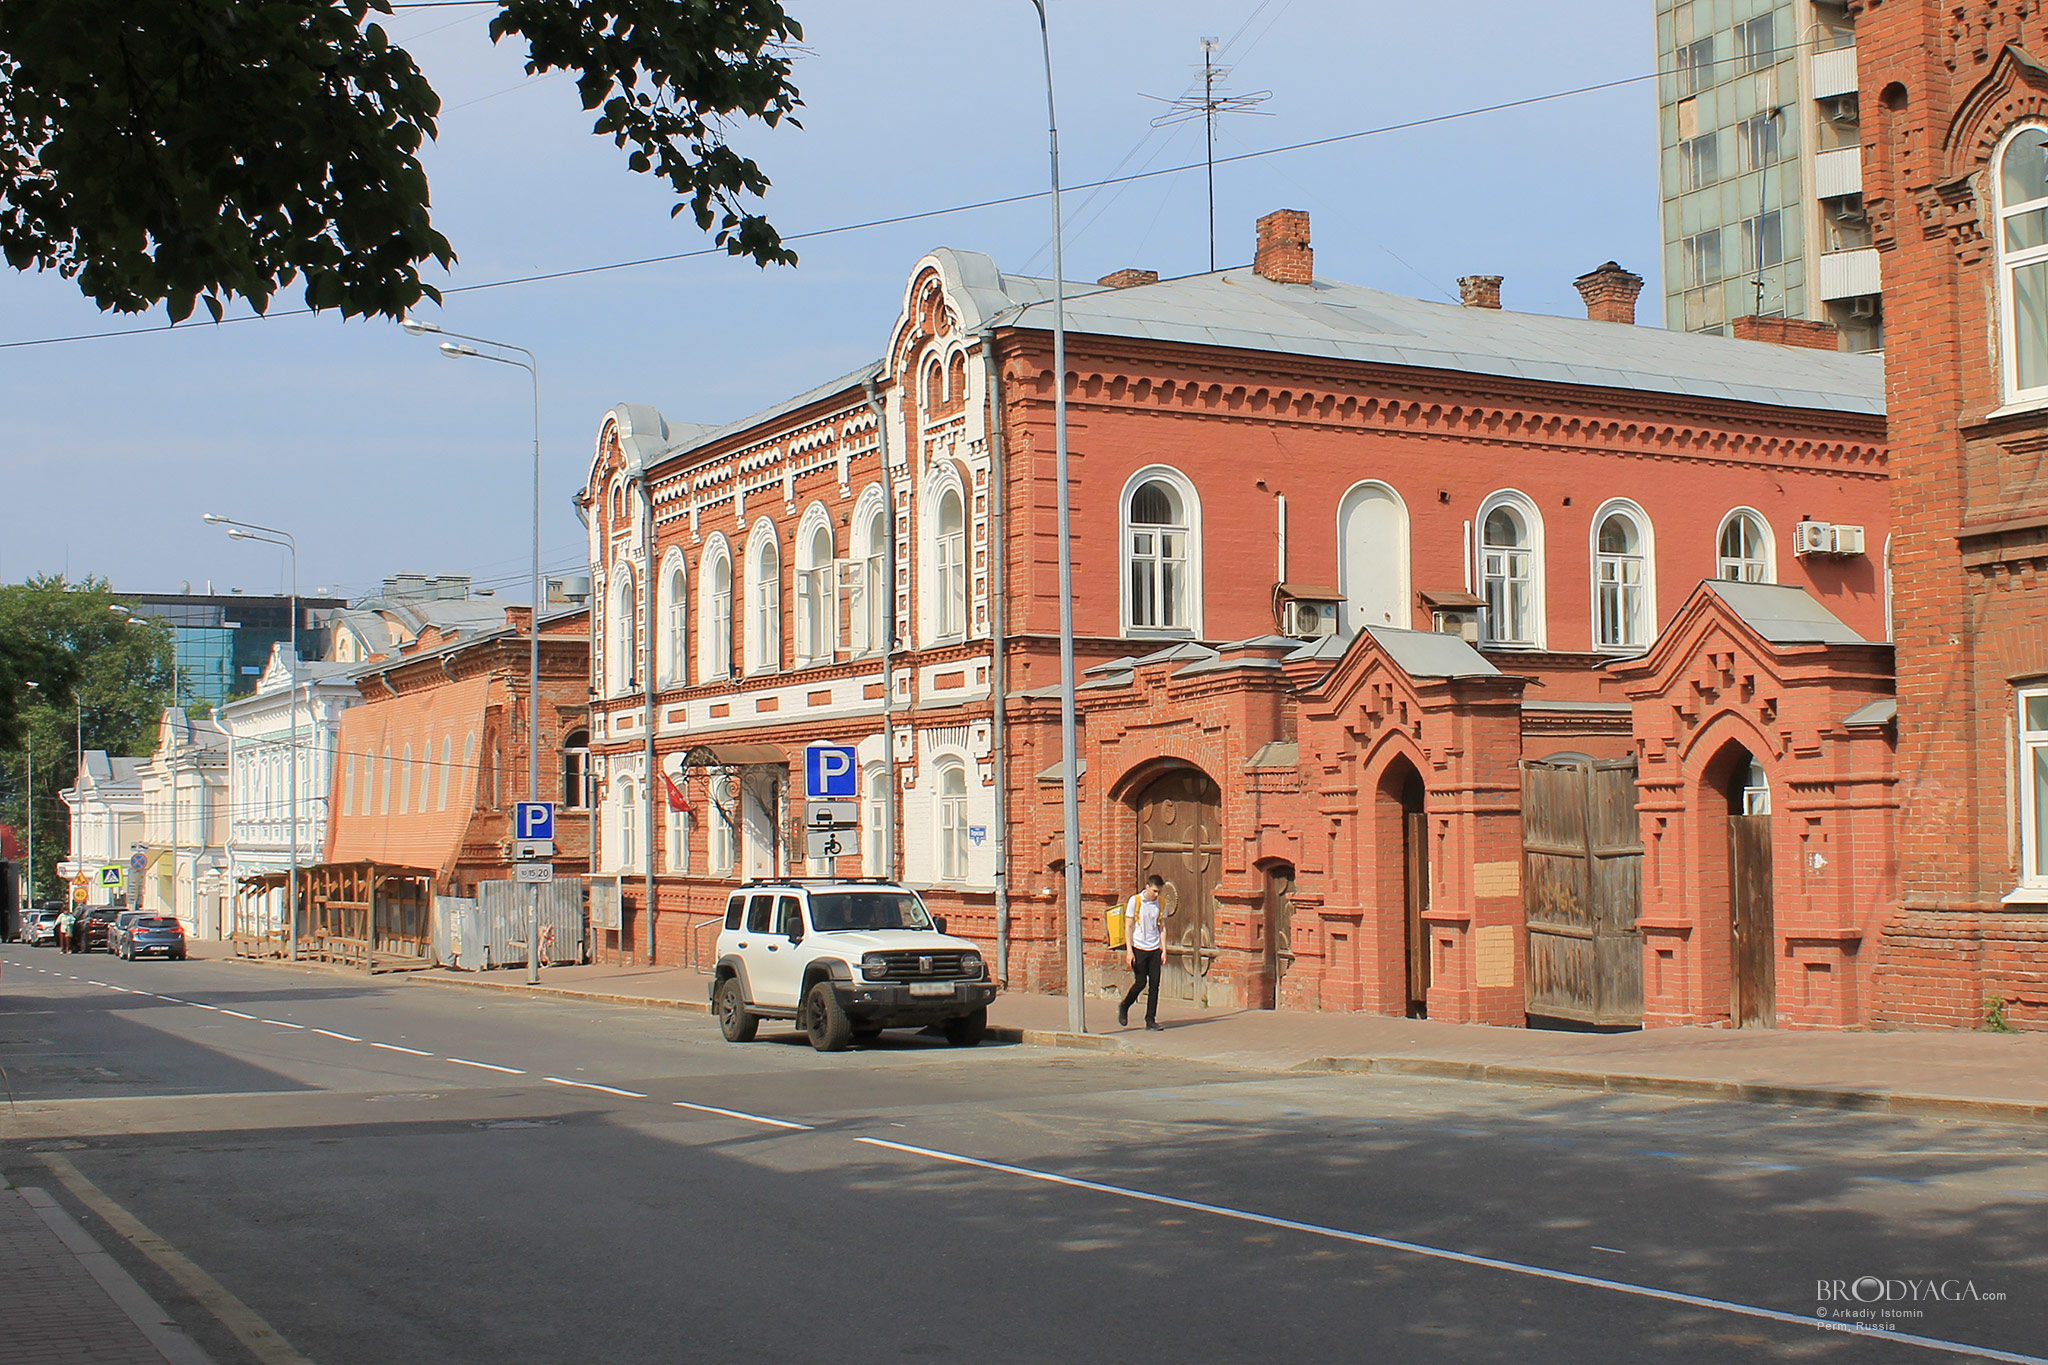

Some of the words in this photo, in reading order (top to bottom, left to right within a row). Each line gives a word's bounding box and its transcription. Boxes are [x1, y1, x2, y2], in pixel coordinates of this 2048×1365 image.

[819, 750, 850, 793] P
[525, 805, 549, 837] P
[538, 868, 549, 877] 20
